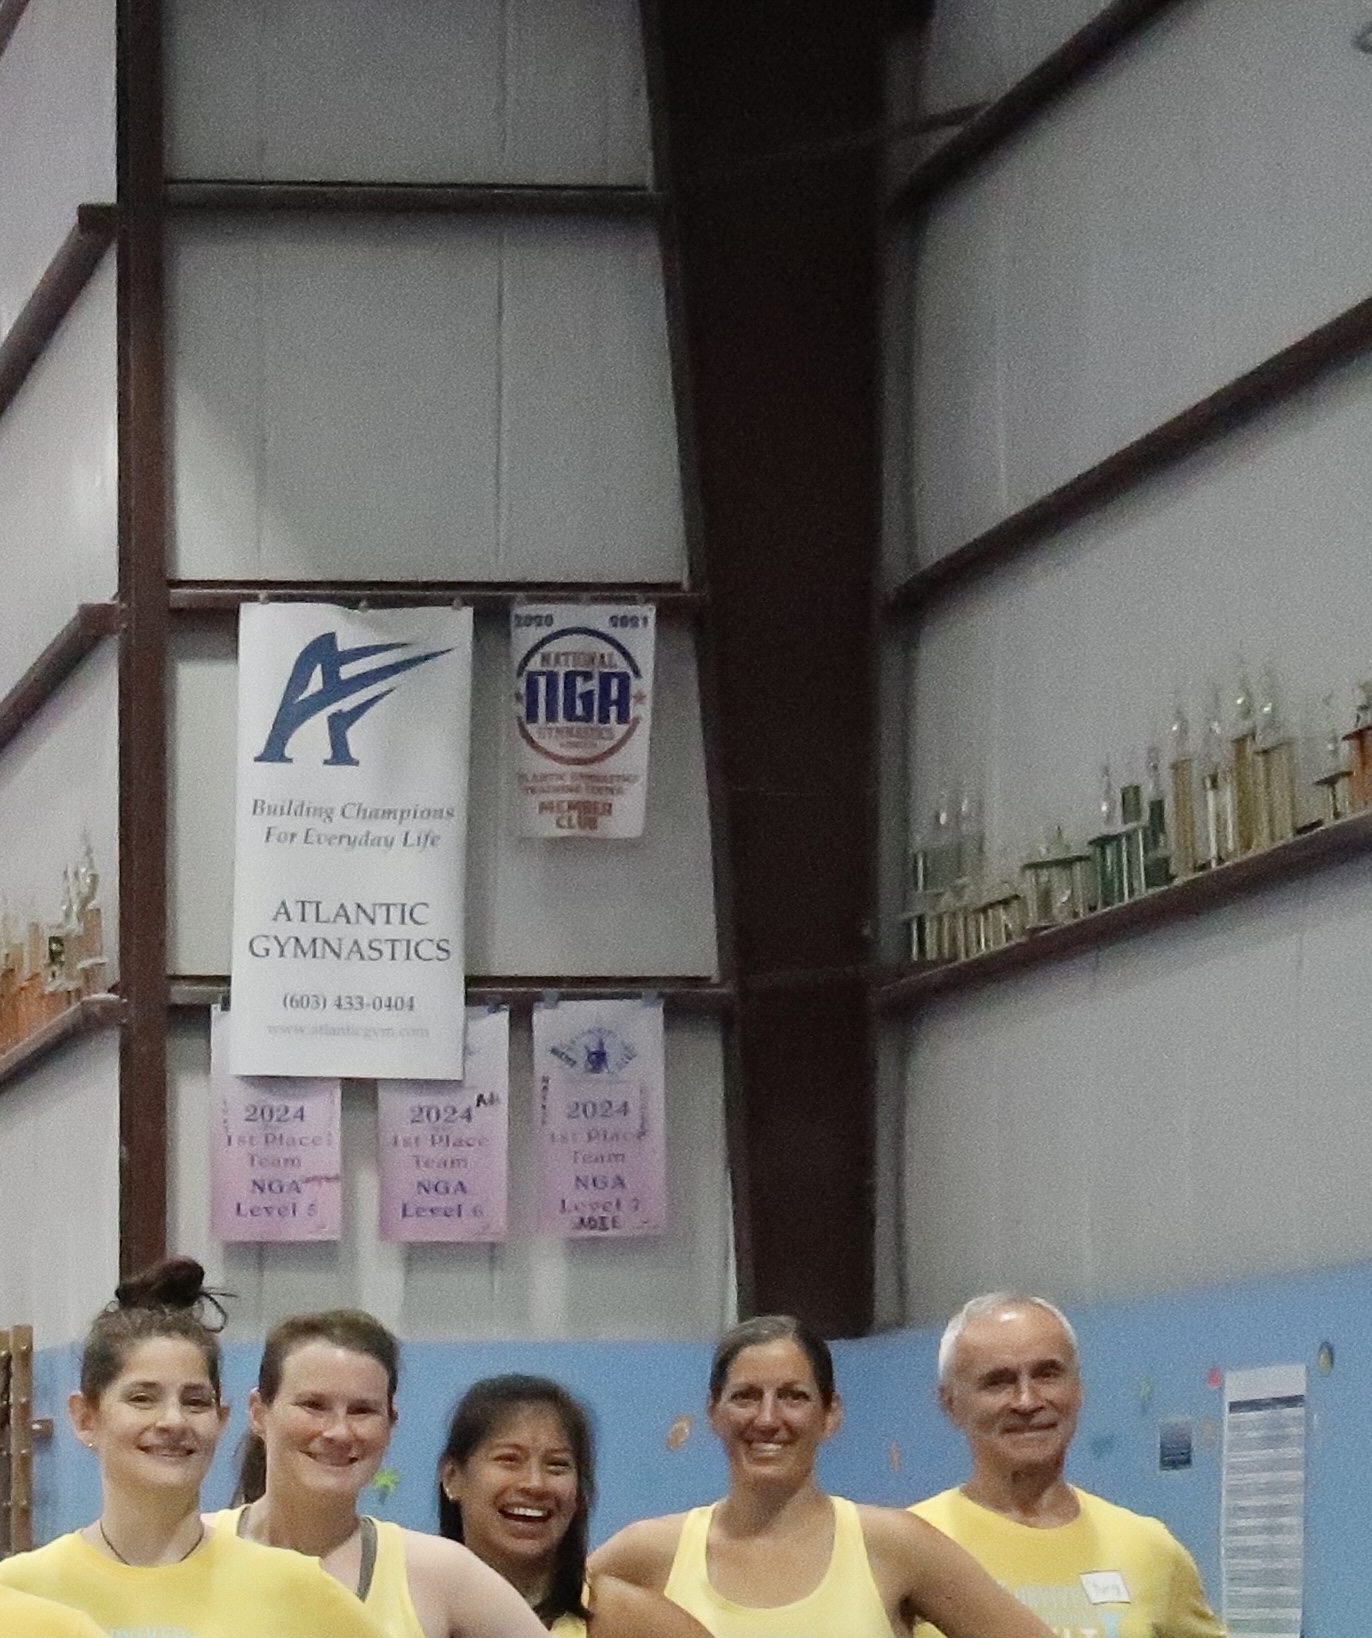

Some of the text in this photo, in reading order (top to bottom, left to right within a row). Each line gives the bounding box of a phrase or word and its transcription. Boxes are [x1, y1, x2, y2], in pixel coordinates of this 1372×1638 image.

[526, 670, 631, 724] NGA
[252, 799, 455, 826] Building Champions
[264, 826, 442, 851] For Everyday Life
[271, 899, 430, 926] ATLANTIC
[248, 934, 452, 962] GYMNASTICS
[282, 994, 416, 1012] (603) 433-0404
[244, 1104, 307, 1124] 2024
[410, 1105, 473, 1124] 2024
[567, 1100, 629, 1120] 2024
[251, 1179, 303, 1195] NGA
[416, 1180, 468, 1195] NGA
[573, 1174, 627, 1191] NGA
[235, 1202, 298, 1218] Level
[401, 1203, 463, 1219] Level
